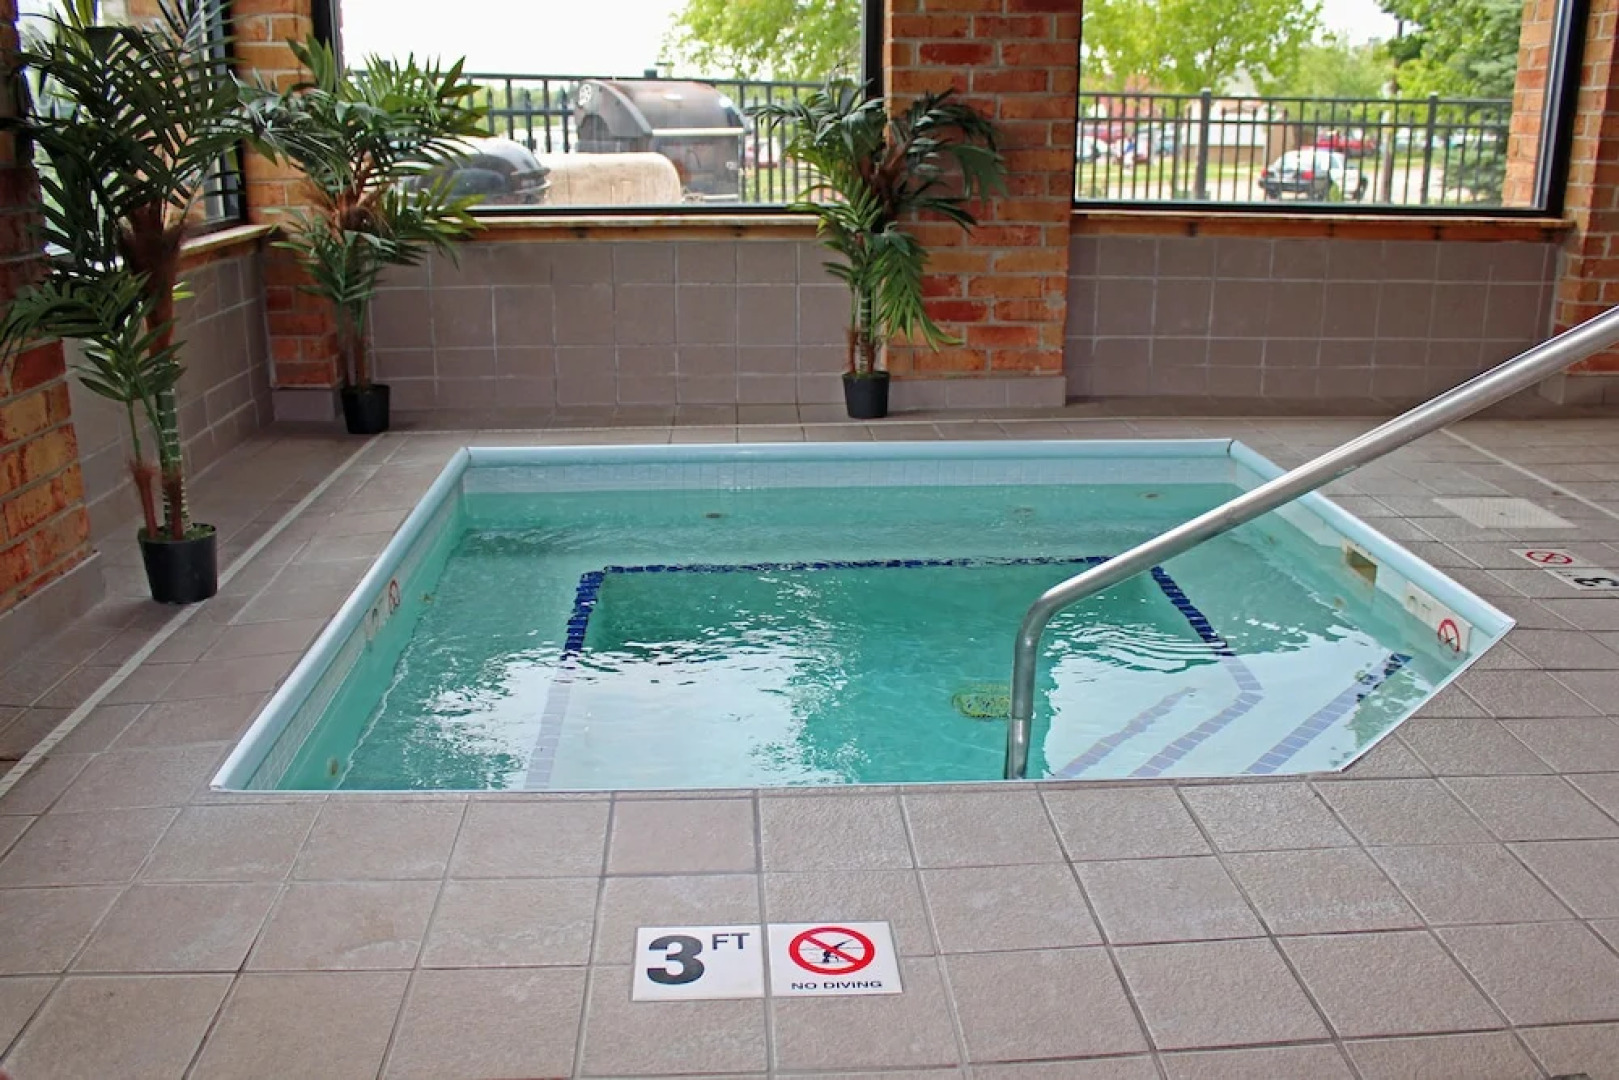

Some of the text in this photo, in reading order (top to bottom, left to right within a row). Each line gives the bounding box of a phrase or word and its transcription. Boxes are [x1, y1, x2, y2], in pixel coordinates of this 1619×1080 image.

[646, 932, 750, 985] 3 FT
[791, 980, 883, 990] NO DIVING
